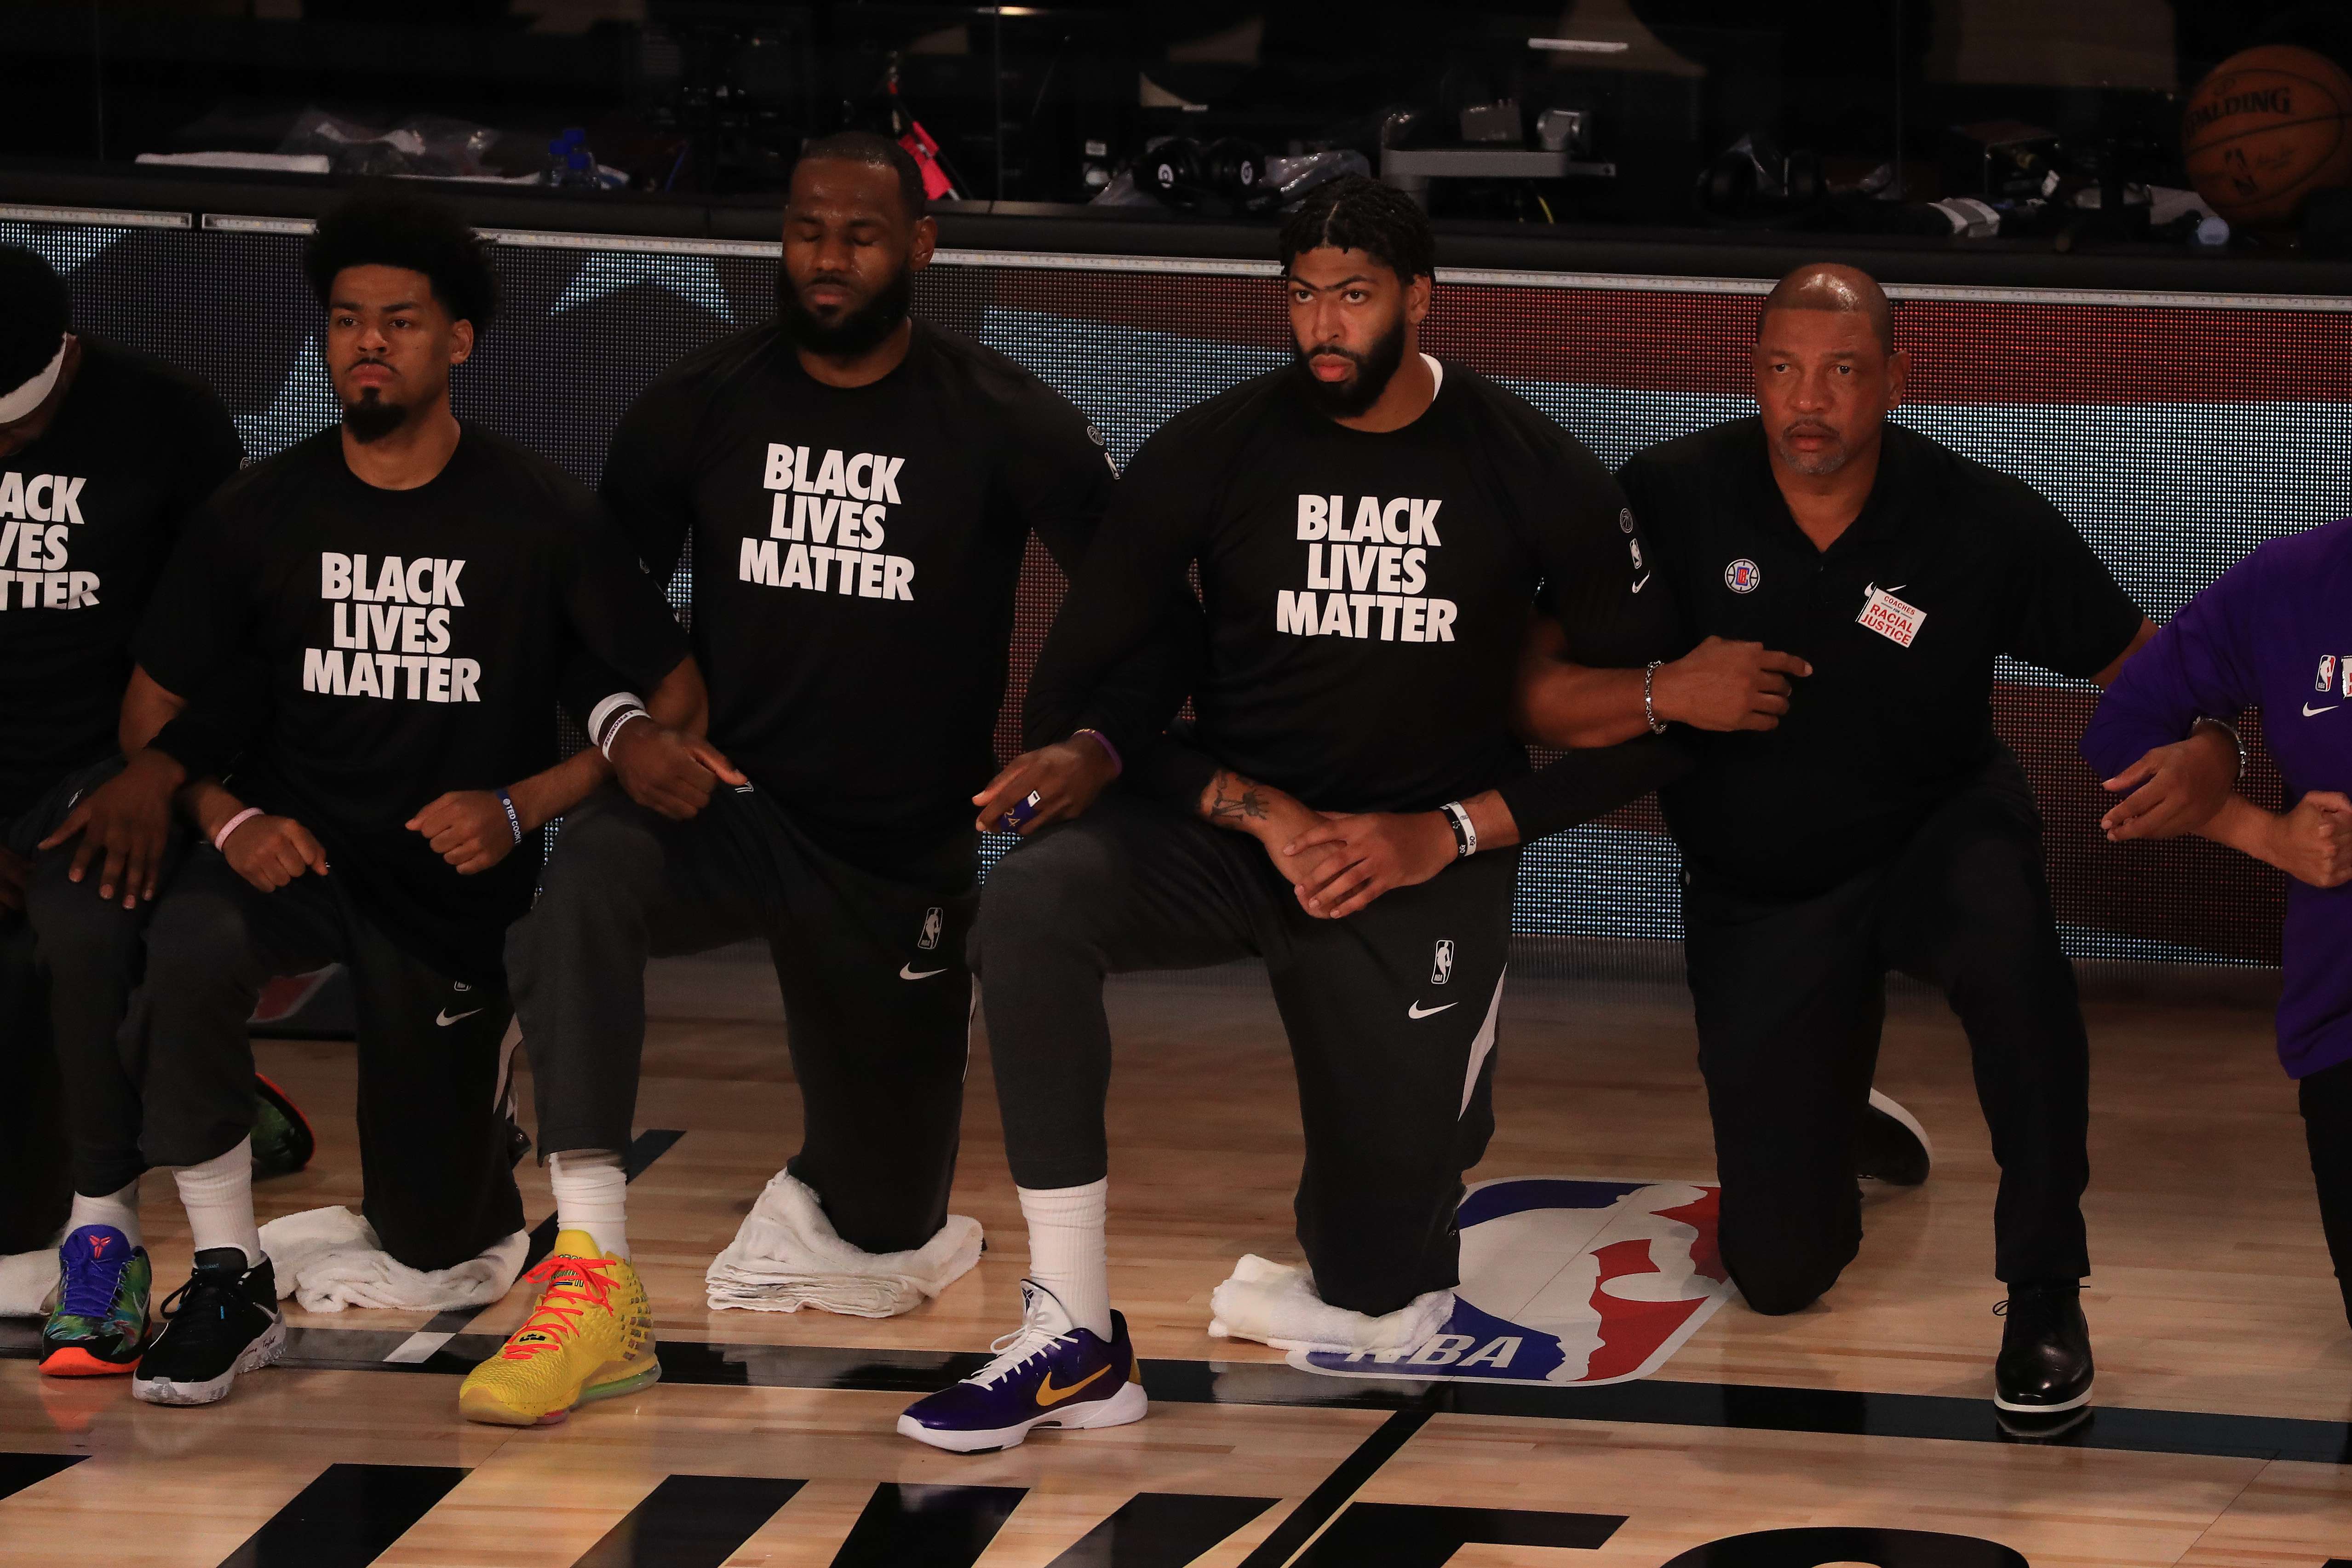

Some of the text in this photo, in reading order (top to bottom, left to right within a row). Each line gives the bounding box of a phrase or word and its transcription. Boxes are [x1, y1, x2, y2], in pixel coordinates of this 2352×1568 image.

[0, 471, 87, 524] ACK
[763, 442, 906, 505] BLACK
[770, 492, 887, 551] LIVES
[1296, 494, 1443, 546] BLACK
[321, 551, 466, 607] BLACK
[739, 537, 915, 601] MATTER
[1307, 543, 1427, 595] LIVES
[333, 602, 451, 655] LIVES
[1276, 589, 1458, 643] MATTER
[1861, 614, 1911, 645] JUSTICE
[1870, 604, 1912, 633] RACIAL
[1884, 596, 1916, 615] COACHES
[303, 647, 481, 703] MATTER
[506, 804, 516, 820] TED
[1344, 1333, 1523, 1368] BA
